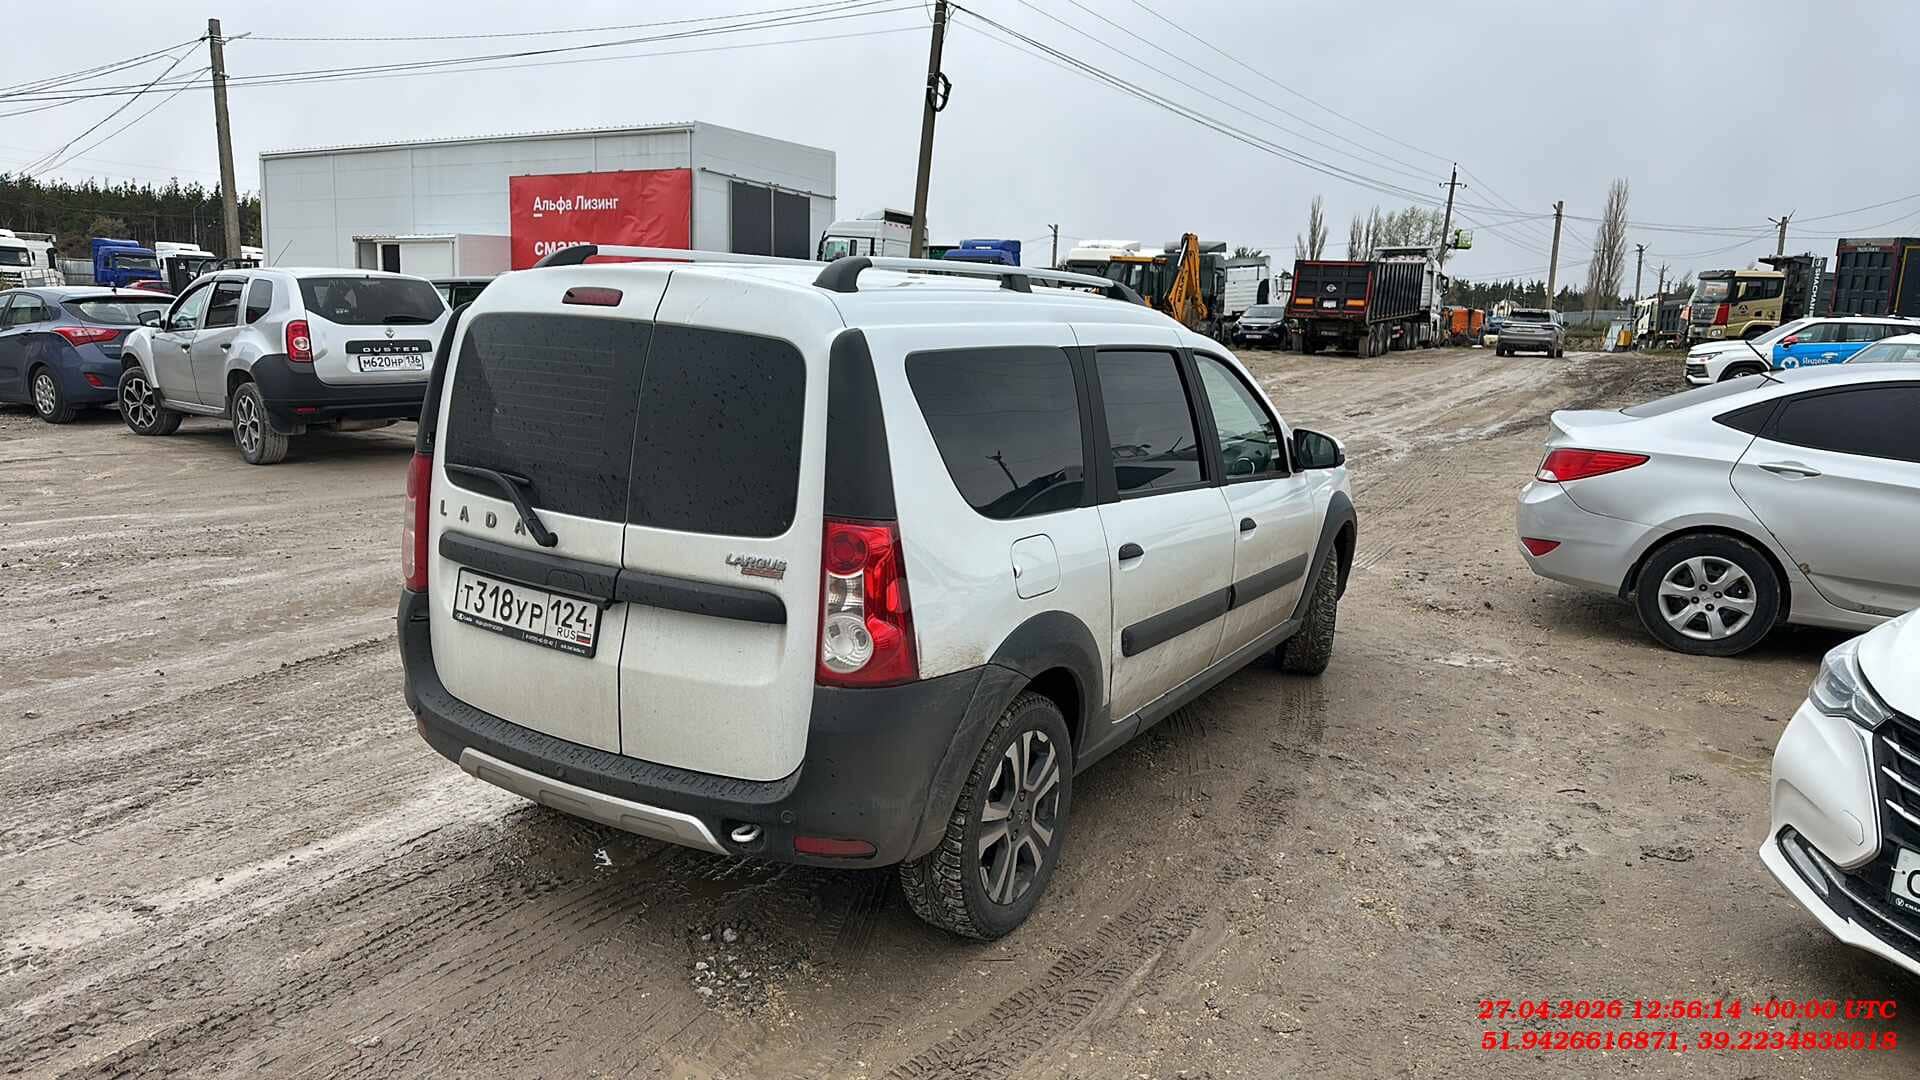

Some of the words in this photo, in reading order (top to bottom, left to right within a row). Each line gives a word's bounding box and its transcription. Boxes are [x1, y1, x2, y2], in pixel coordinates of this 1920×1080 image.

[533, 196, 572, 214] Альфа
[575, 195, 619, 210] Лизинг
[534, 241, 591, 256] сма
[406, 356, 421, 364] 136
[440, 499, 527, 536] LADA
[463, 580, 543, 629] Т318УР
[550, 599, 588, 632] 124
[556, 626, 576, 641] RUS
